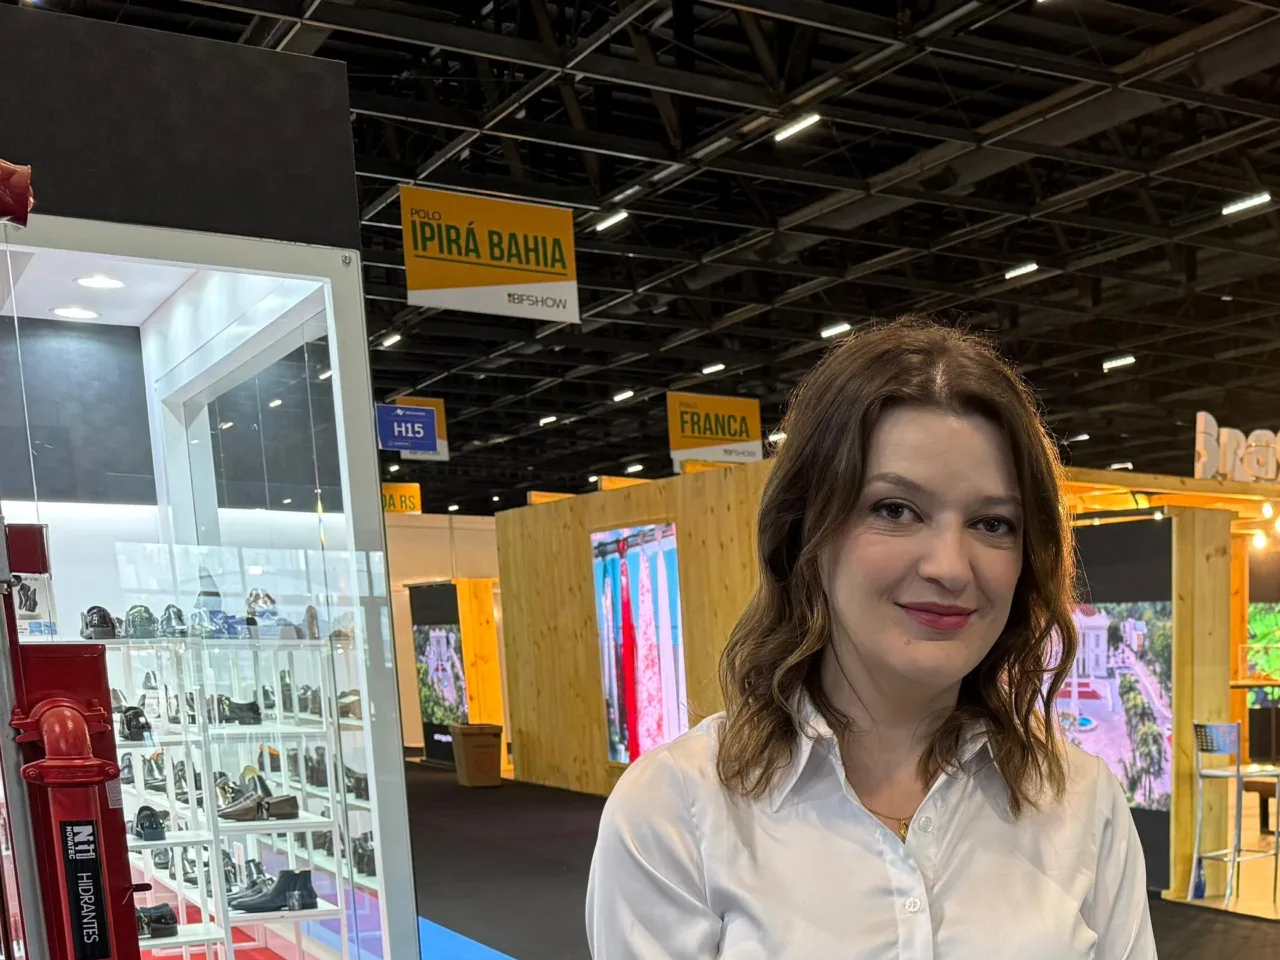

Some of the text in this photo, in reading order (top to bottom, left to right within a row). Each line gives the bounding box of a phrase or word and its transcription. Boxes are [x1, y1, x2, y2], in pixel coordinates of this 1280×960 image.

[410, 207, 442, 221] POLO
[411, 220, 568, 271] IPIRÁ BAHIA
[511, 292, 568, 310] BFSHOW
[393, 421, 425, 438] H15
[680, 410, 750, 439] FRANCA
[65, 825, 76, 860] NOVATEC
[76, 872, 99, 944] HIDRANTES
